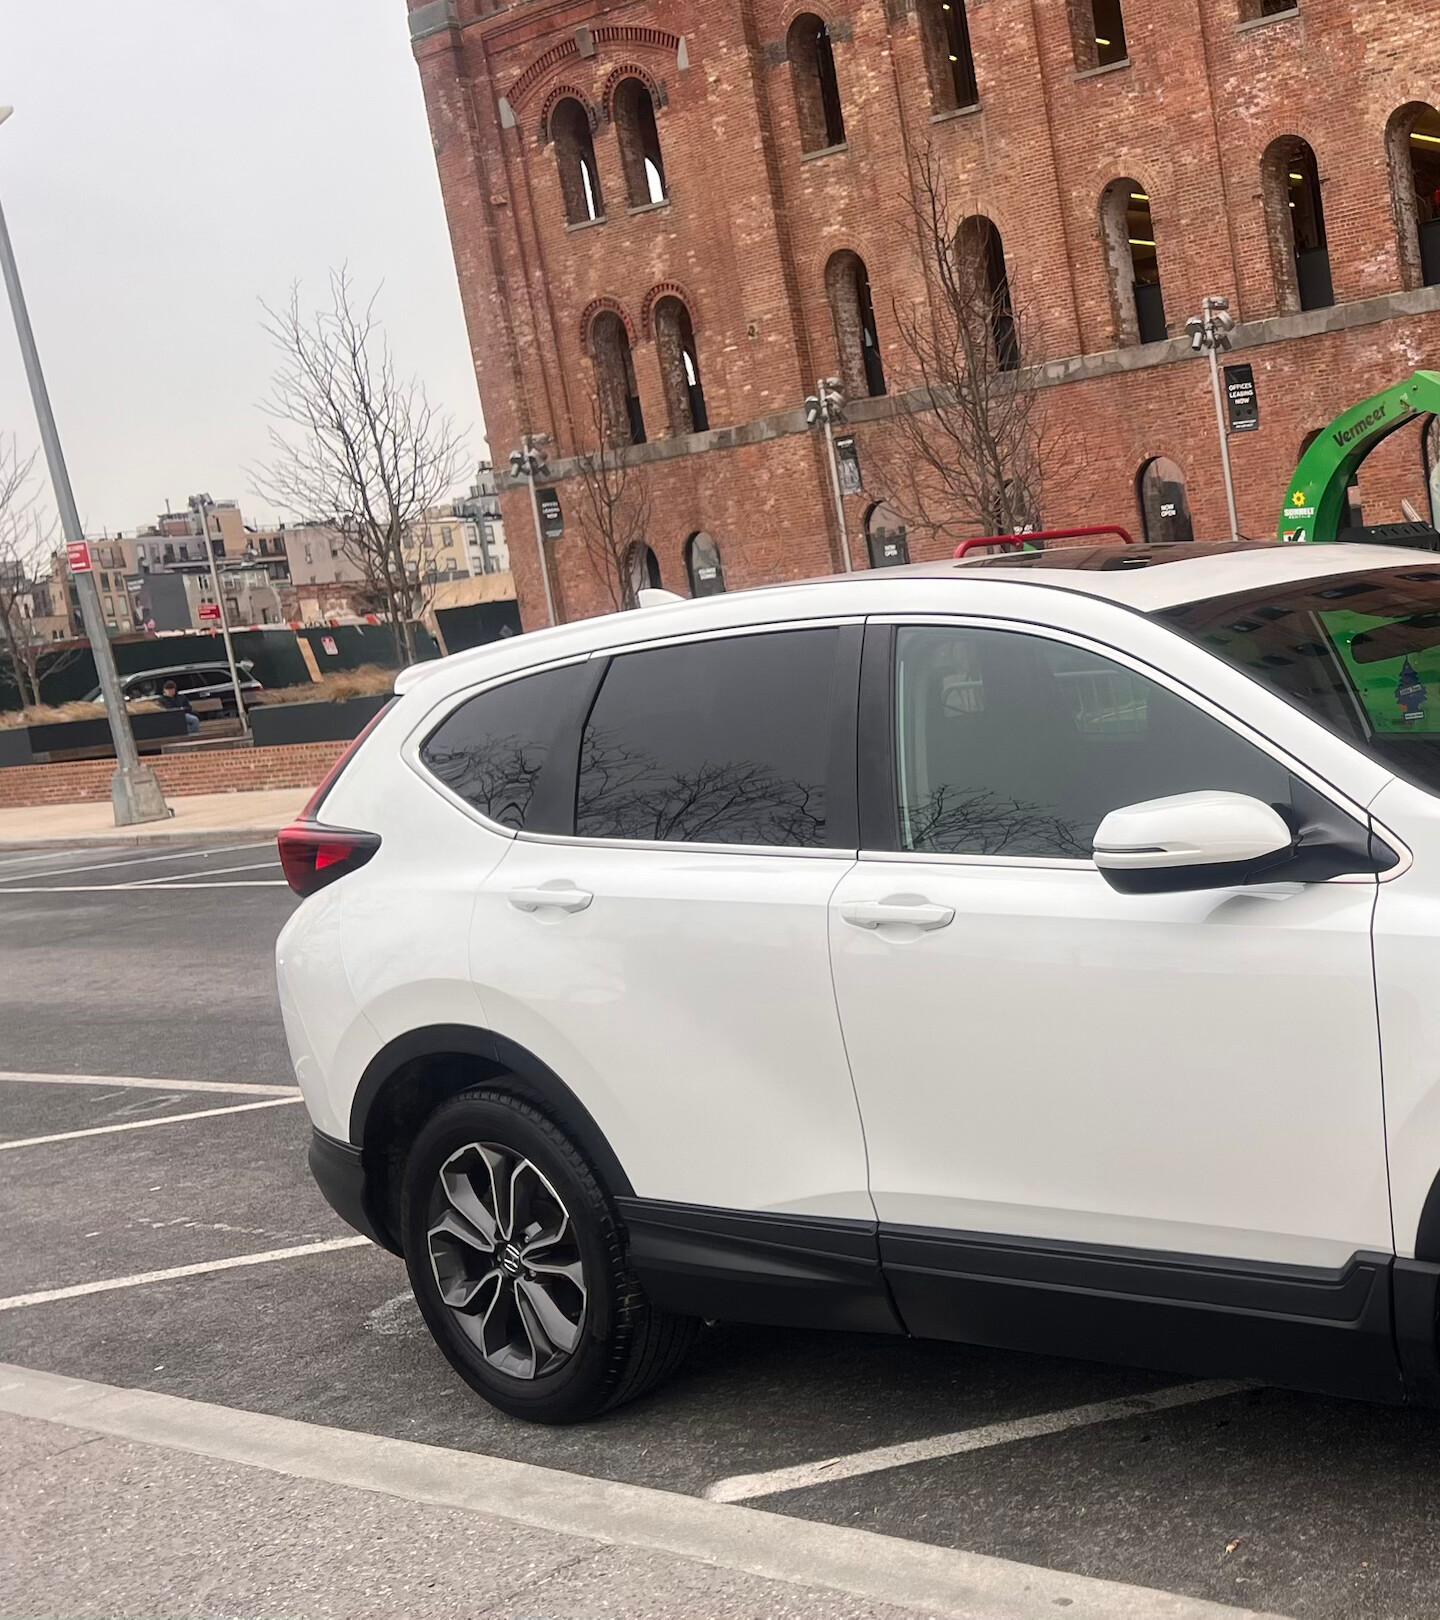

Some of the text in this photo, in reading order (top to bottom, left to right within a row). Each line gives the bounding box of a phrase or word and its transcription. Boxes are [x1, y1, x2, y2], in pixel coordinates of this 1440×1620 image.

[1228, 382, 1252, 391] OFFICES
[1229, 390, 1254, 399] LEASING
[1332, 405, 1386, 447] Vermeer
